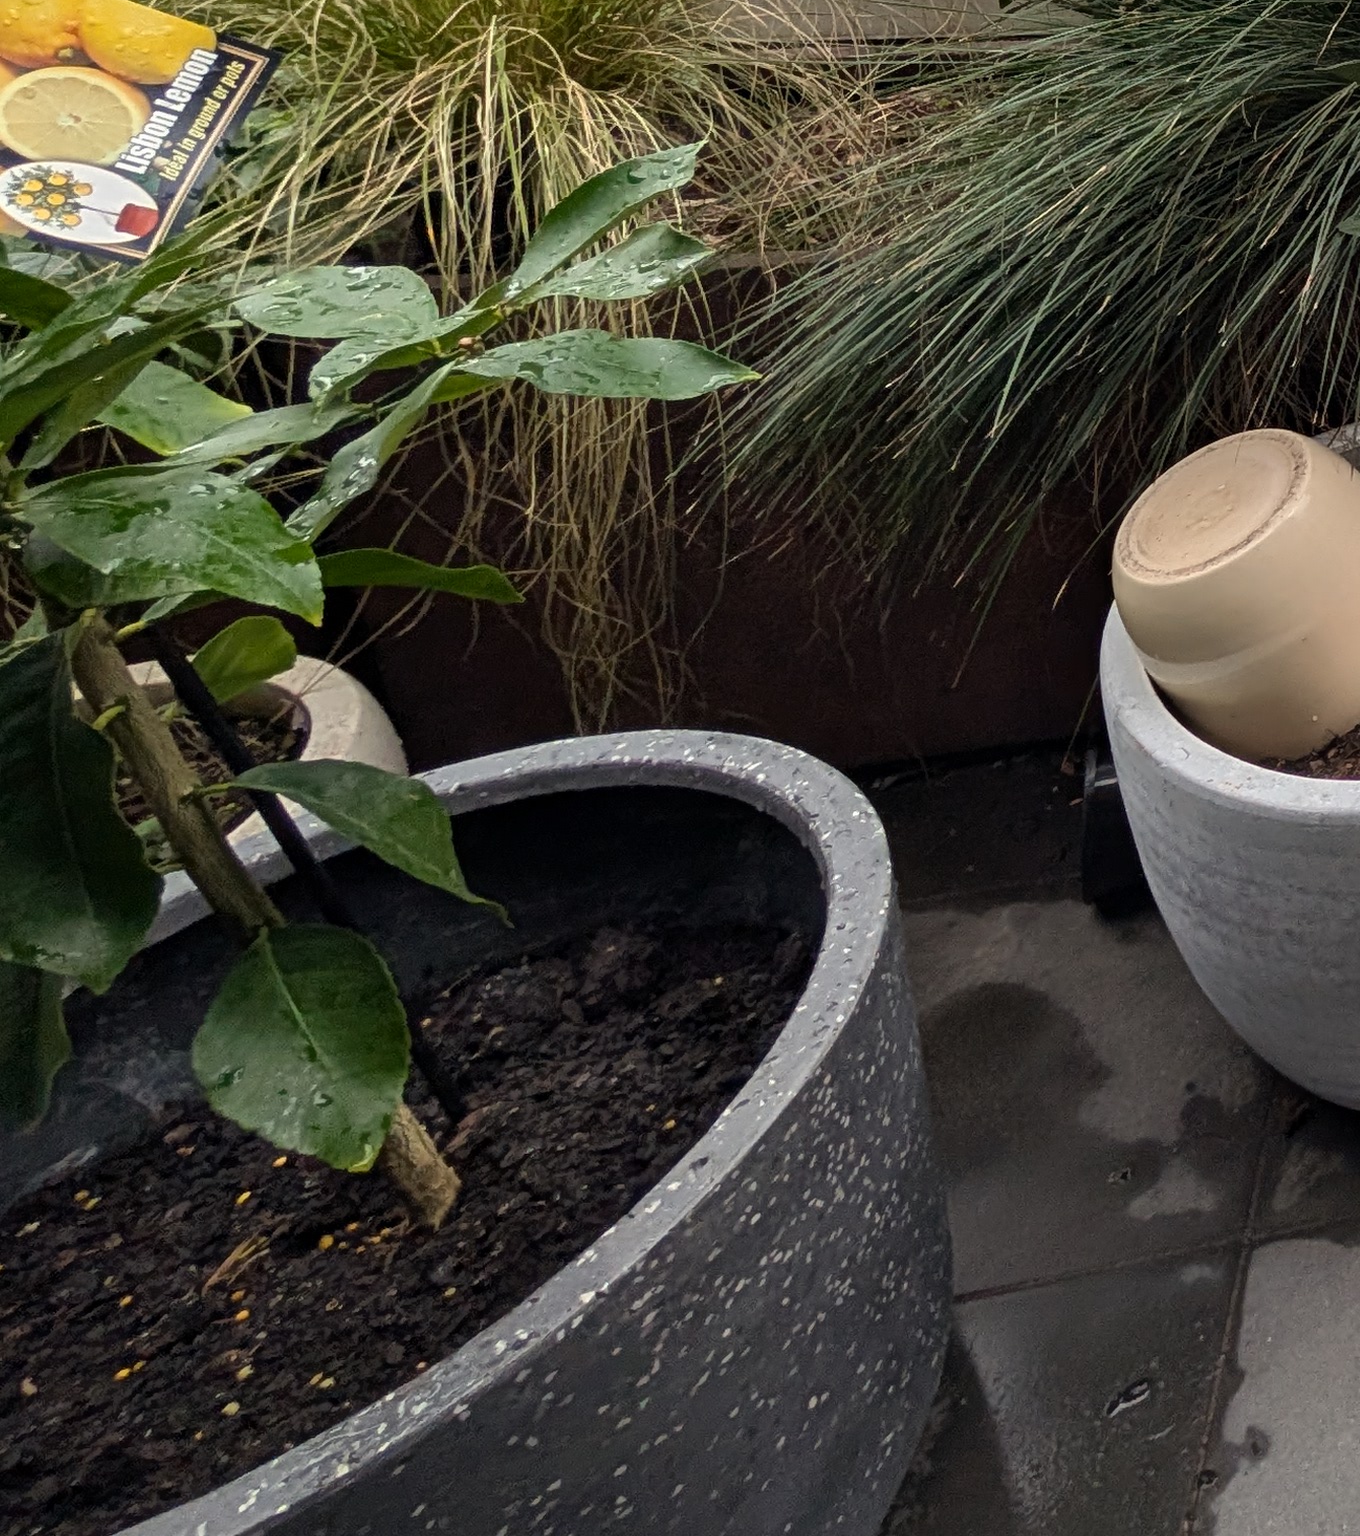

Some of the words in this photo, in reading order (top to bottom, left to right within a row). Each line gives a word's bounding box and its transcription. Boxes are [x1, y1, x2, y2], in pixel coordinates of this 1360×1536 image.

[220, 60, 246, 89] pots
[213, 84, 229, 101] or
[114, 111, 178, 174] Lisbon
[154, 49, 218, 112] Lemon
[188, 97, 221, 140] ground
[177, 139, 197, 152] in
[159, 149, 189, 181] Ideal
